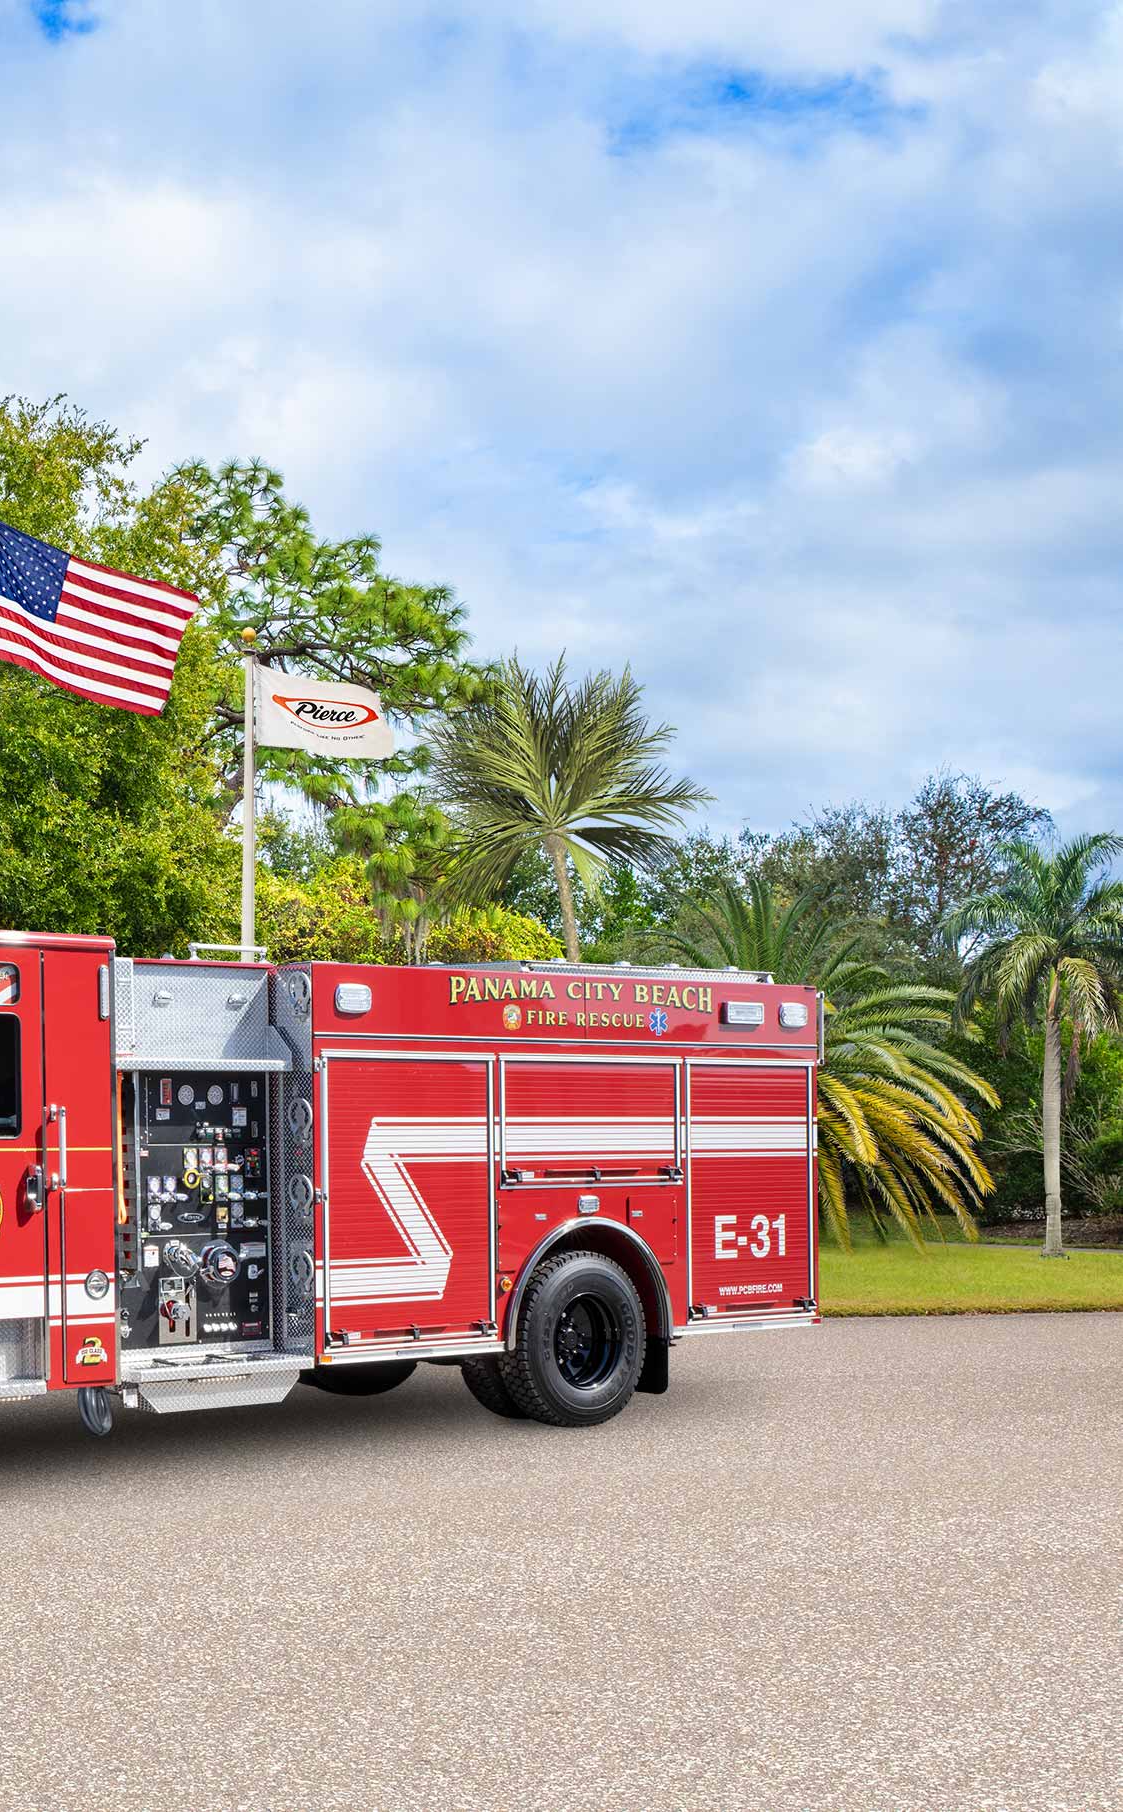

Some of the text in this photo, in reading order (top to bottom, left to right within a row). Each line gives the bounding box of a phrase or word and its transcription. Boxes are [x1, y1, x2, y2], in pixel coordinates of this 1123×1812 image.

[295, 701, 357, 723] Pierce
[449, 976, 714, 1014] PANAMA CITY BEACH
[526, 1010, 646, 1029] FIRE RESCUE
[714, 1213, 786, 1259] E-31
[719, 1283, 783, 1297] WWW.PCBFIRE.COM
